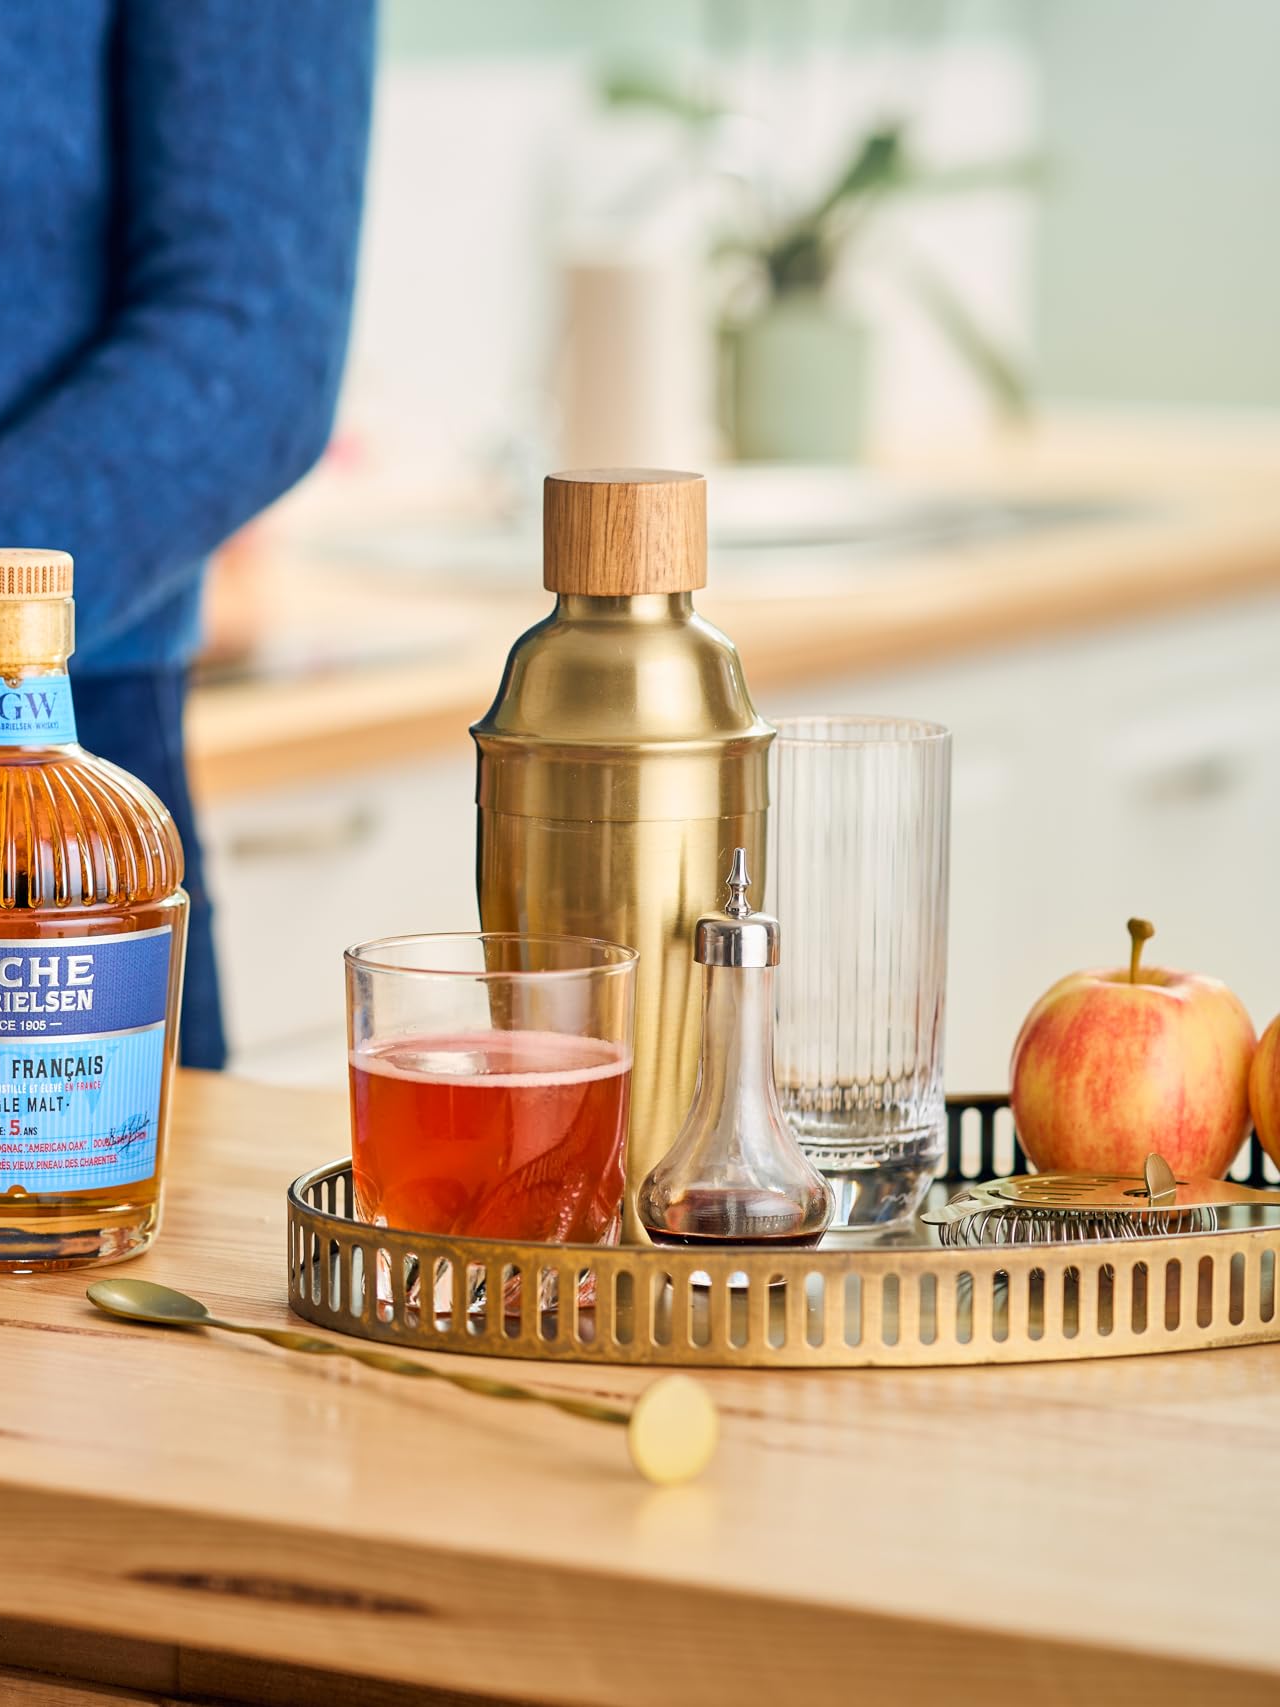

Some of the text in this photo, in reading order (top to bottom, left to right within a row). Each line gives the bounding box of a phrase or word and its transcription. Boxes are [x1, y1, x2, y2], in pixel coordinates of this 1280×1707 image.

[20, 1020, 47, 1031] 1905
[12, 1055, 104, 1082] FRANÇAIS
[29, 1084, 38, 1093] ET
[65, 1083, 74, 1092] EN
[76, 1080, 102, 1091] FRANCE
[27, 1096, 64, 1112] MALT
[9, 1119, 20, 1136] 5
[23, 1126, 38, 1136] ANS
[12, 1160, 34, 1171] VIEUX
[36, 1160, 64, 1170] PINEAU
[65, 1160, 80, 1169] DES
